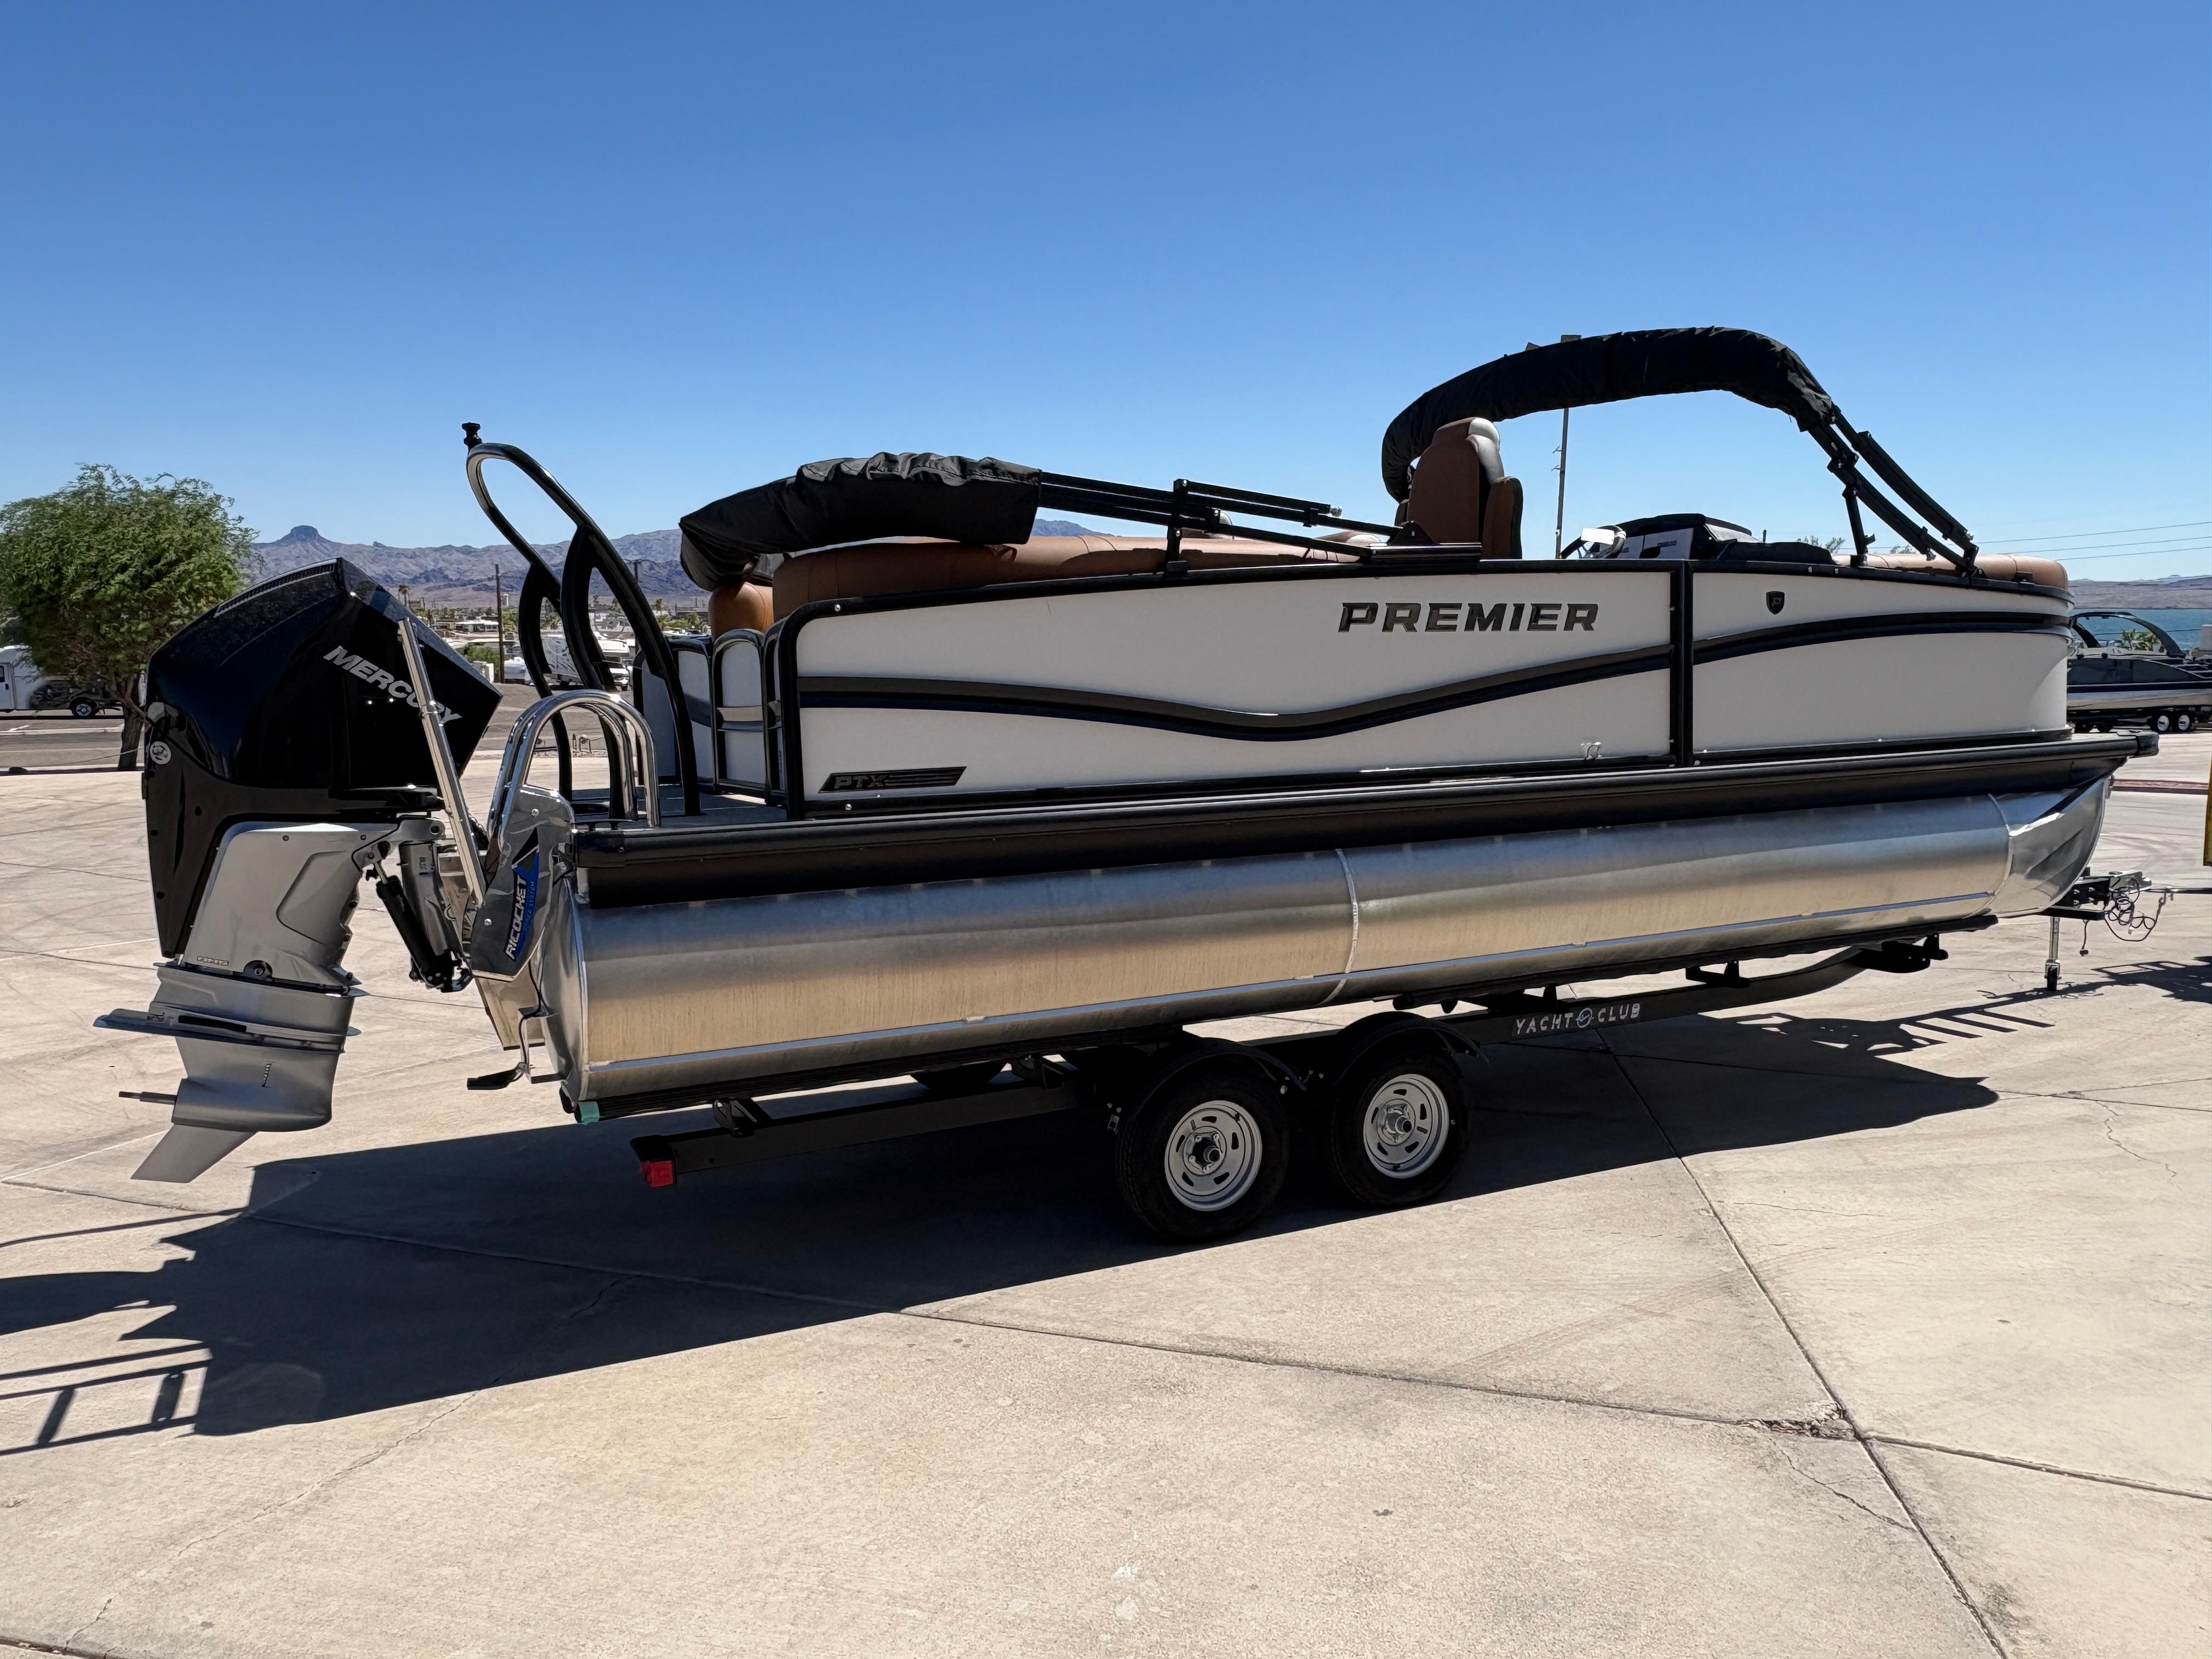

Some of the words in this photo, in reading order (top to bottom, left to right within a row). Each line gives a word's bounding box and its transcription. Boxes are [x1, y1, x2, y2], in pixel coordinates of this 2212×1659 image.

[1338, 602, 1599, 633] PREMIER
[323, 645, 462, 724] MERCY
[834, 775, 887, 789] PTX
[505, 874, 527, 960] RICOCHET
[1516, 1013, 1573, 1035] YACHT
[1598, 1003, 1640, 1023] CLUB
